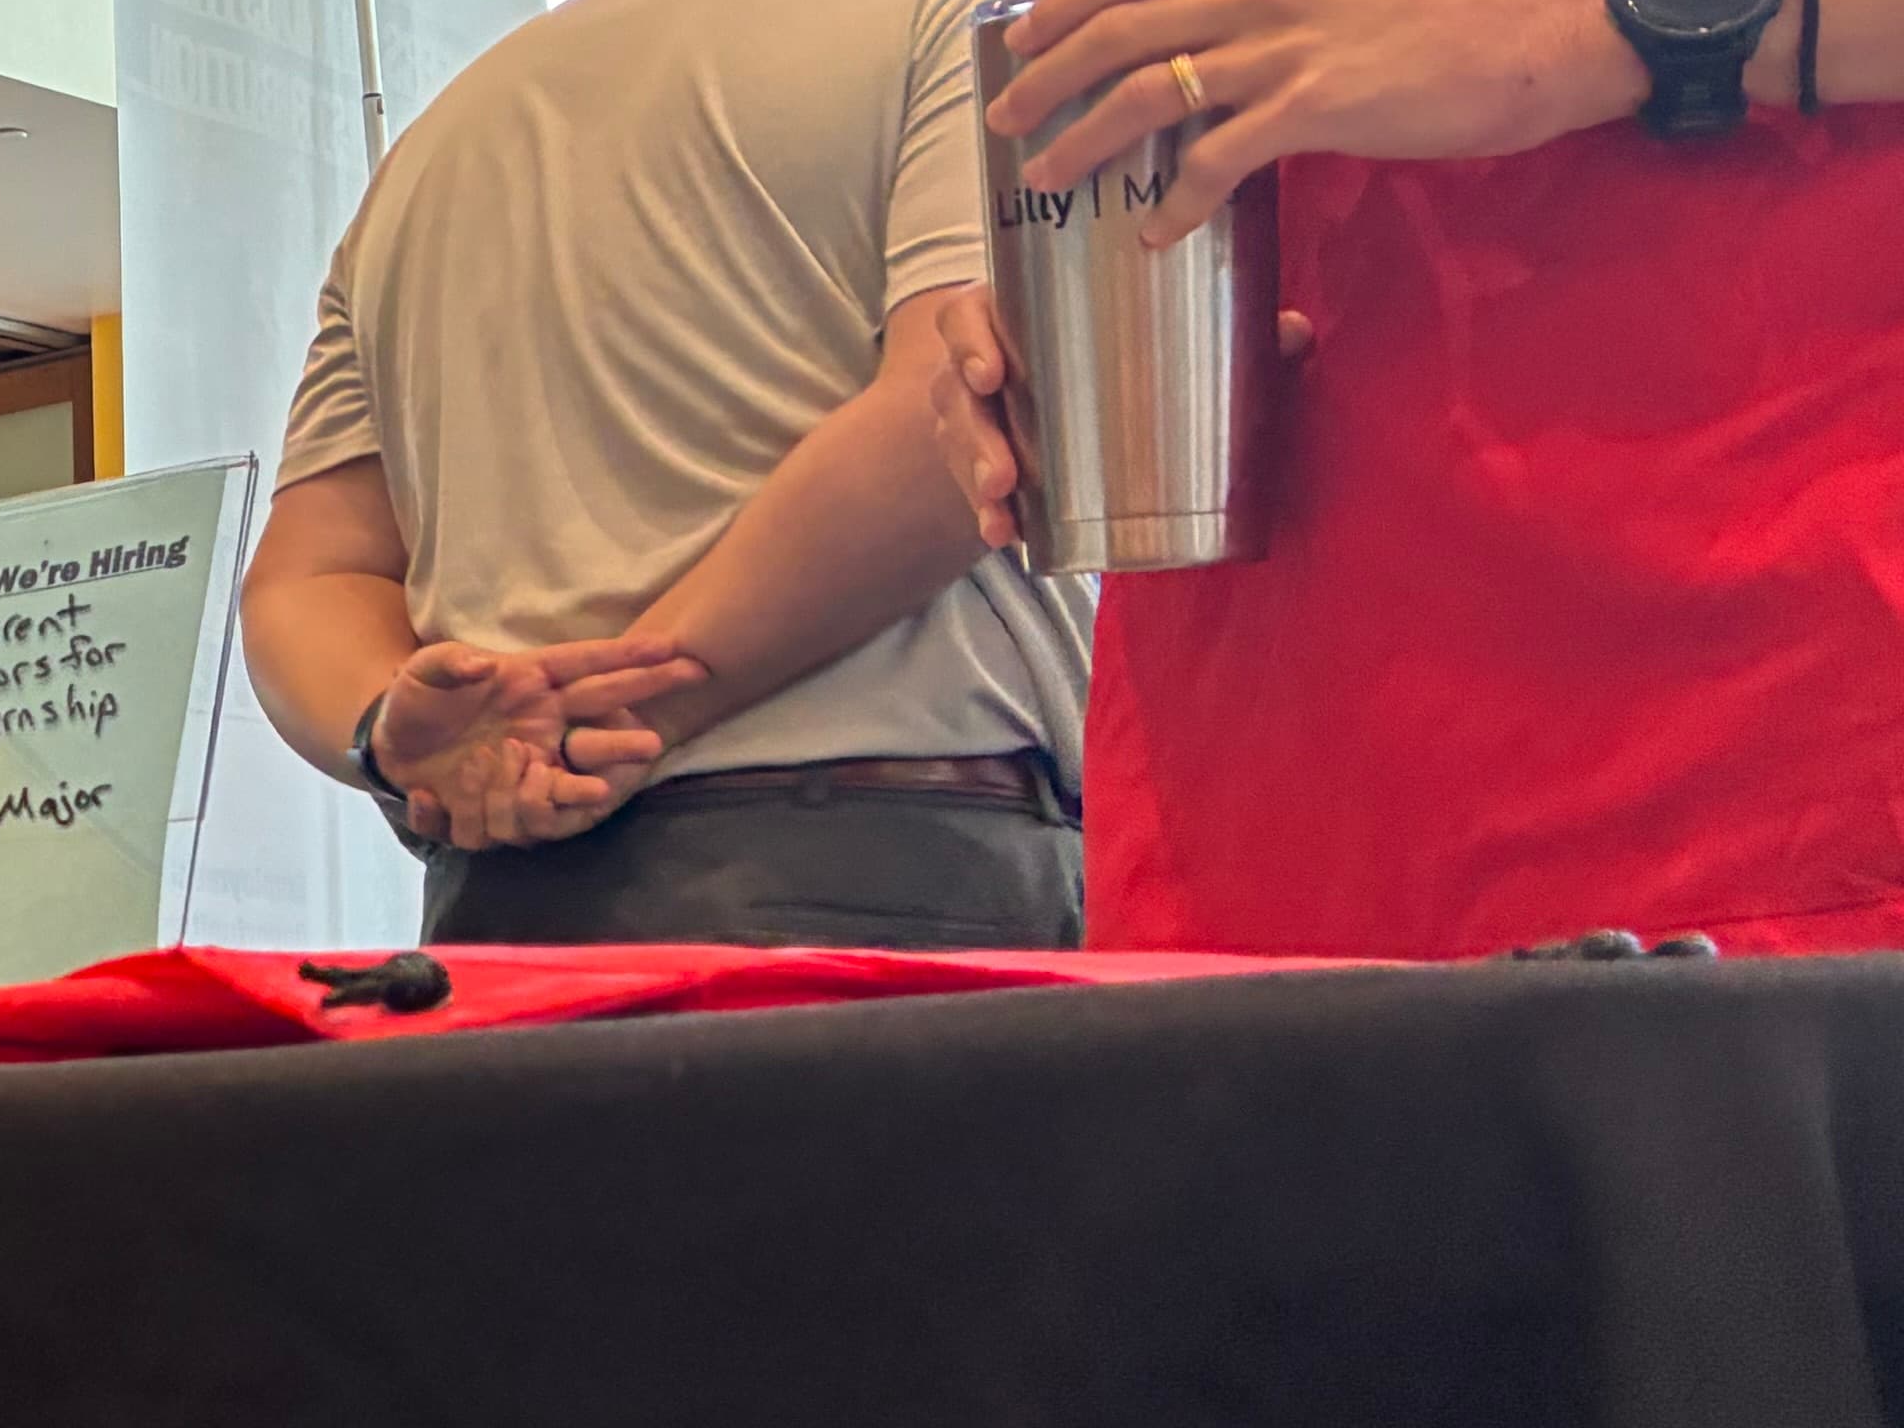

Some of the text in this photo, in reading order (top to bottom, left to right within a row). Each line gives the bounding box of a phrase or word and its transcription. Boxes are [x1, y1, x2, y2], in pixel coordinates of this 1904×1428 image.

[997, 185, 1074, 229] Lilly
[88, 535, 190, 578] Hiring
[60, 635, 127, 669] for
